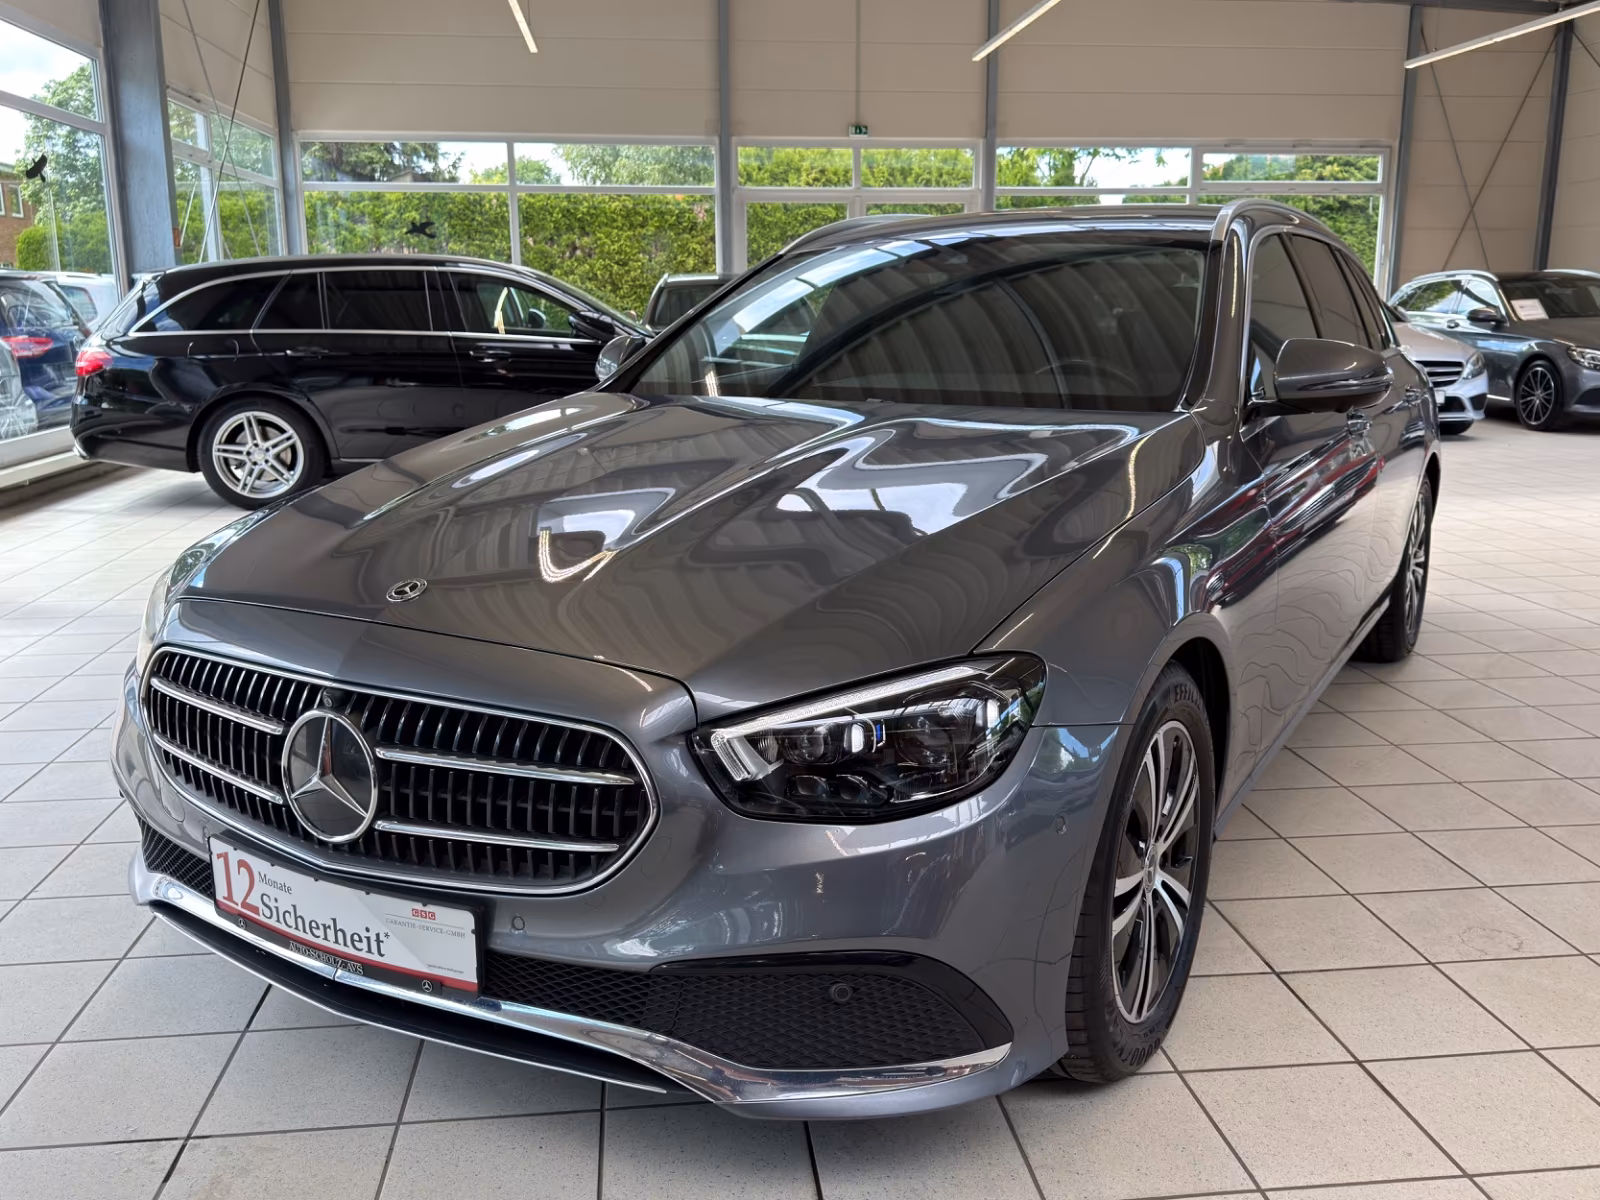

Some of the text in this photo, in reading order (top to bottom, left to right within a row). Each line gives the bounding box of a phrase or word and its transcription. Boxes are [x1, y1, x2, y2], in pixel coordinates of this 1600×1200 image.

[216, 851, 260, 917] 12
[258, 871, 293, 895] Monate
[412, 908, 436, 920] GSG
